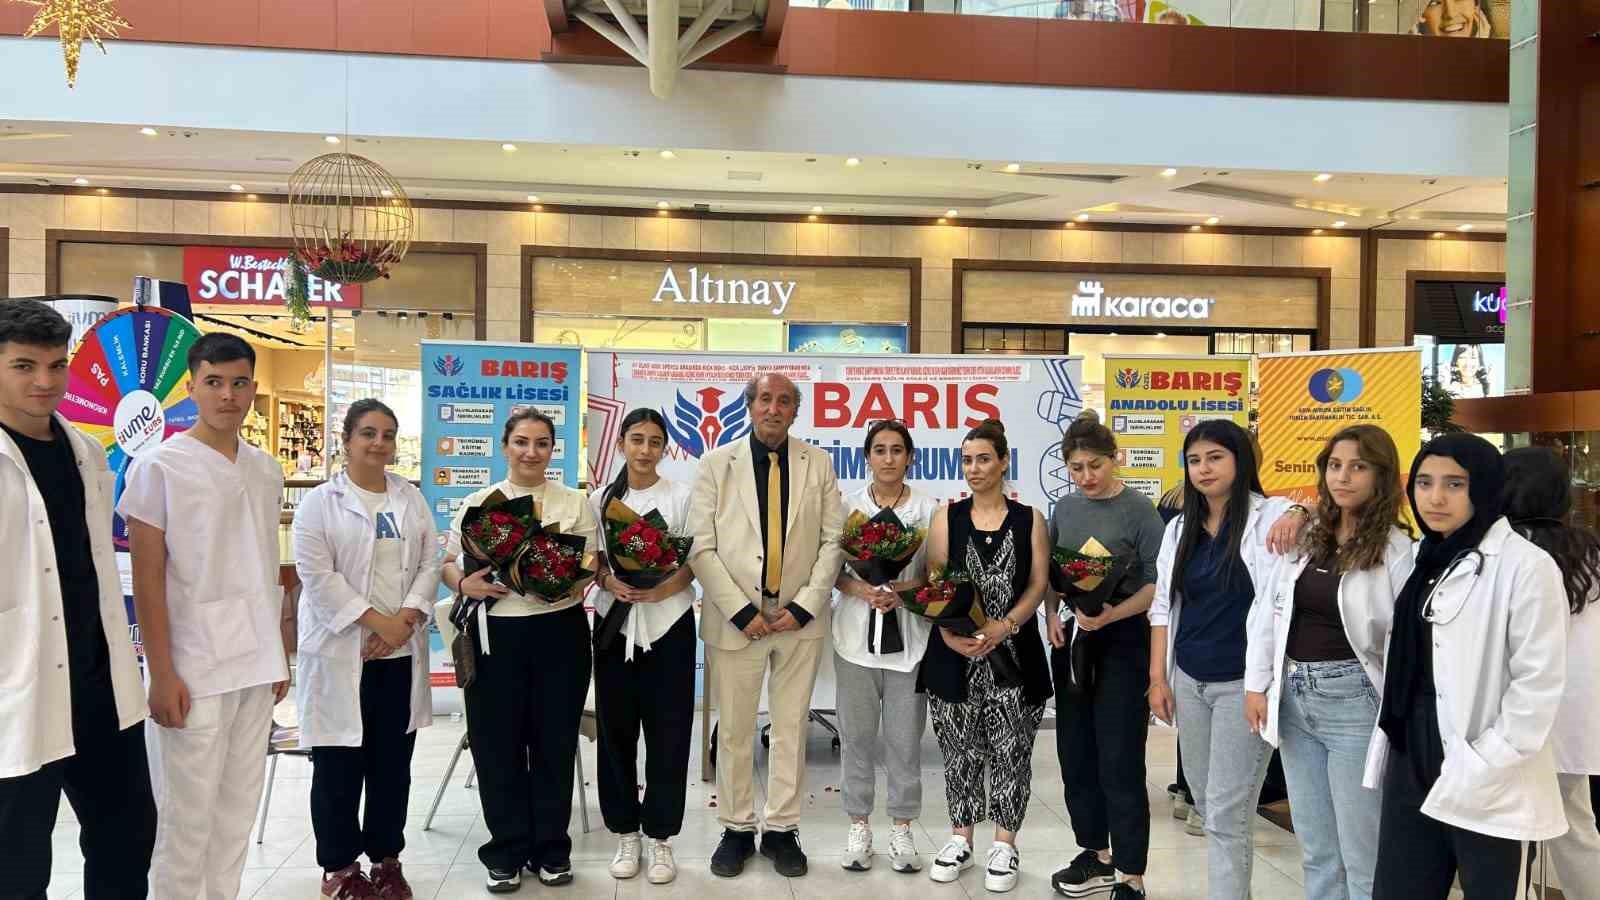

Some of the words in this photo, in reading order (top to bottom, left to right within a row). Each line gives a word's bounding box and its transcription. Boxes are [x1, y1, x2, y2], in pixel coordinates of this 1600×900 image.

[199, 269, 344, 302] SCHAER
[652, 267, 796, 315] Altınay
[1105, 296, 1208, 318] karaca
[142, 321, 151, 359] BANKASI
[90, 362, 110, 387] PAS
[480, 359, 568, 384] BARIŞ
[1151, 371, 1242, 396] BARIŞ
[428, 382, 501, 399] SAĞLIK
[506, 384, 568, 401] LİSESİ
[1110, 399, 1189, 411] ANADOLU
[1192, 397, 1243, 411] LİSESİ
[1275, 460, 1316, 473] Senin
